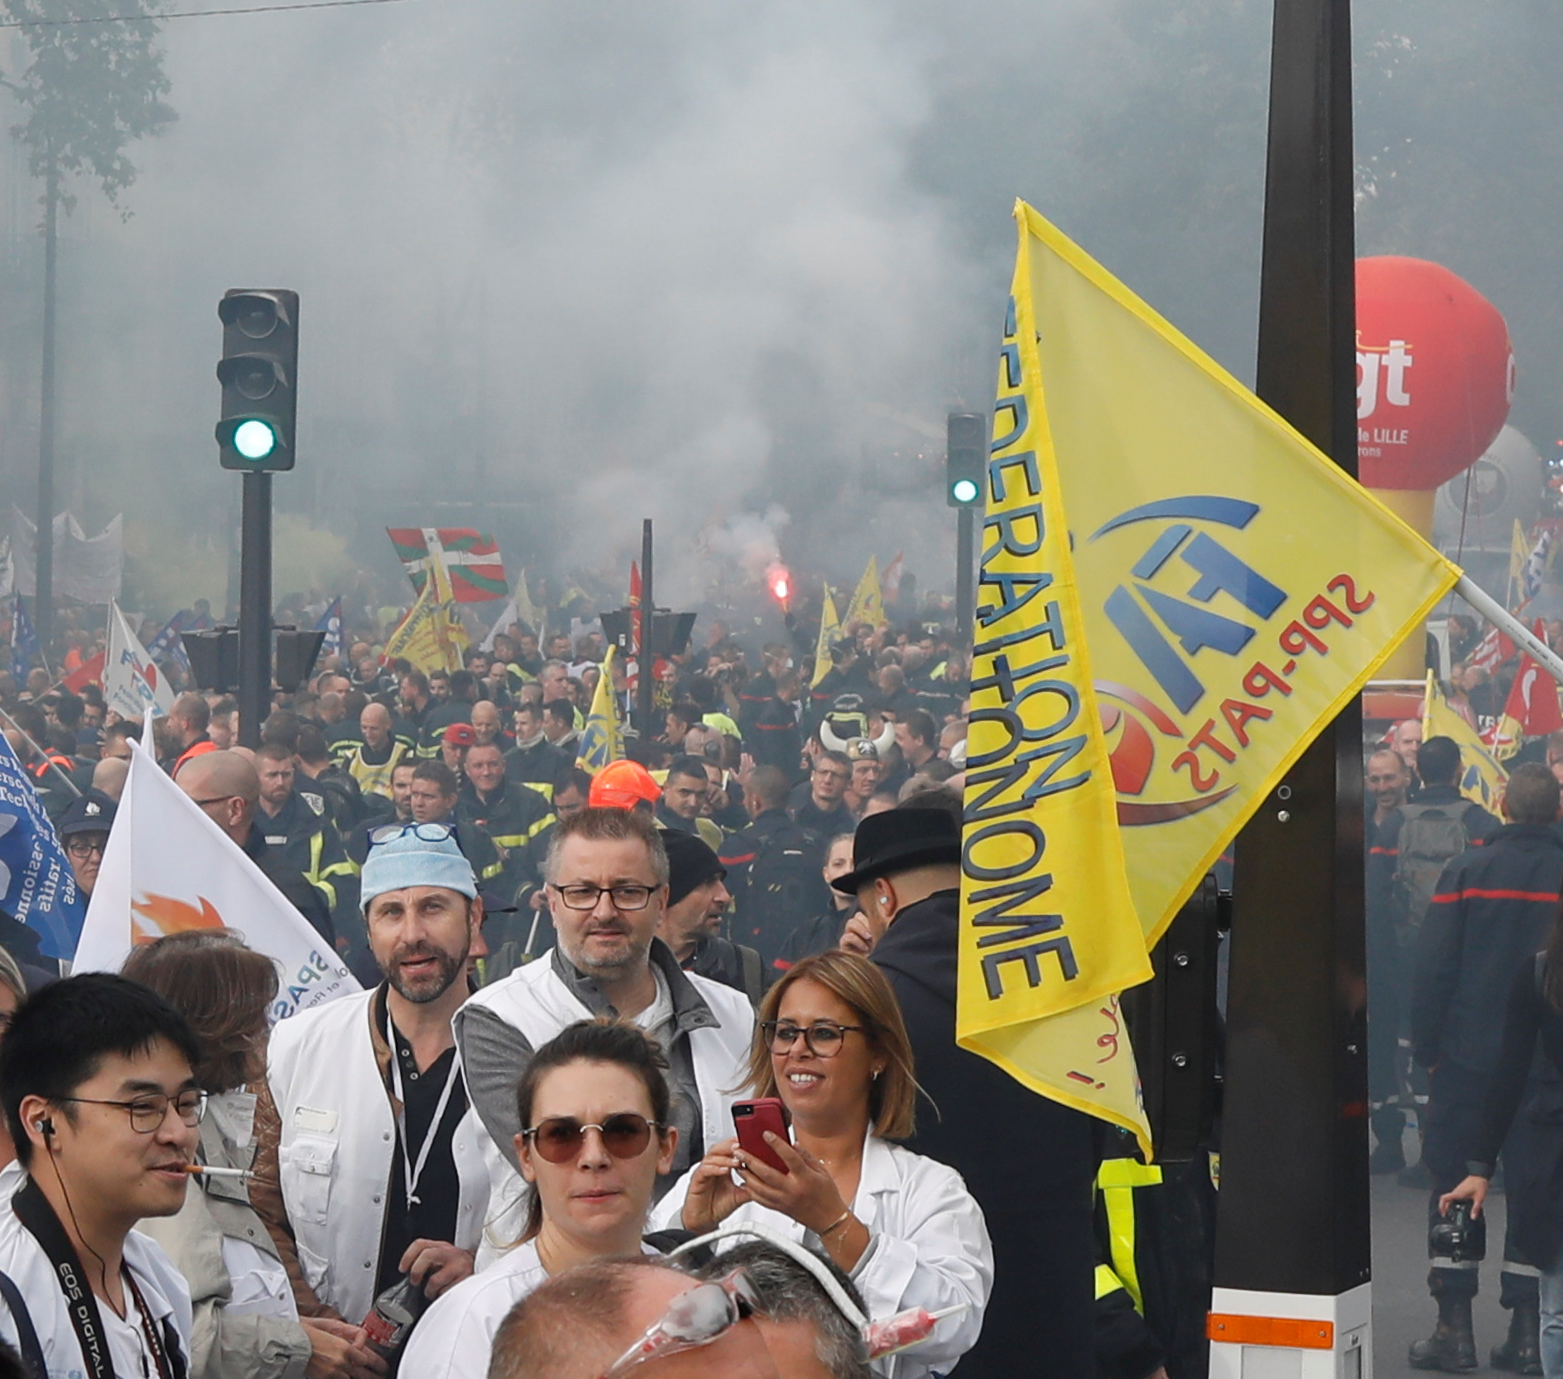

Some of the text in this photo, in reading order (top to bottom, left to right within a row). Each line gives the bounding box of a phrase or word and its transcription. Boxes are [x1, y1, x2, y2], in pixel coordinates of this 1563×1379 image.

[1357, 340, 1413, 420] gt
[1374, 429, 1409, 445] LILLE
[58, 1261, 103, 1379] EOS DIGITAL
